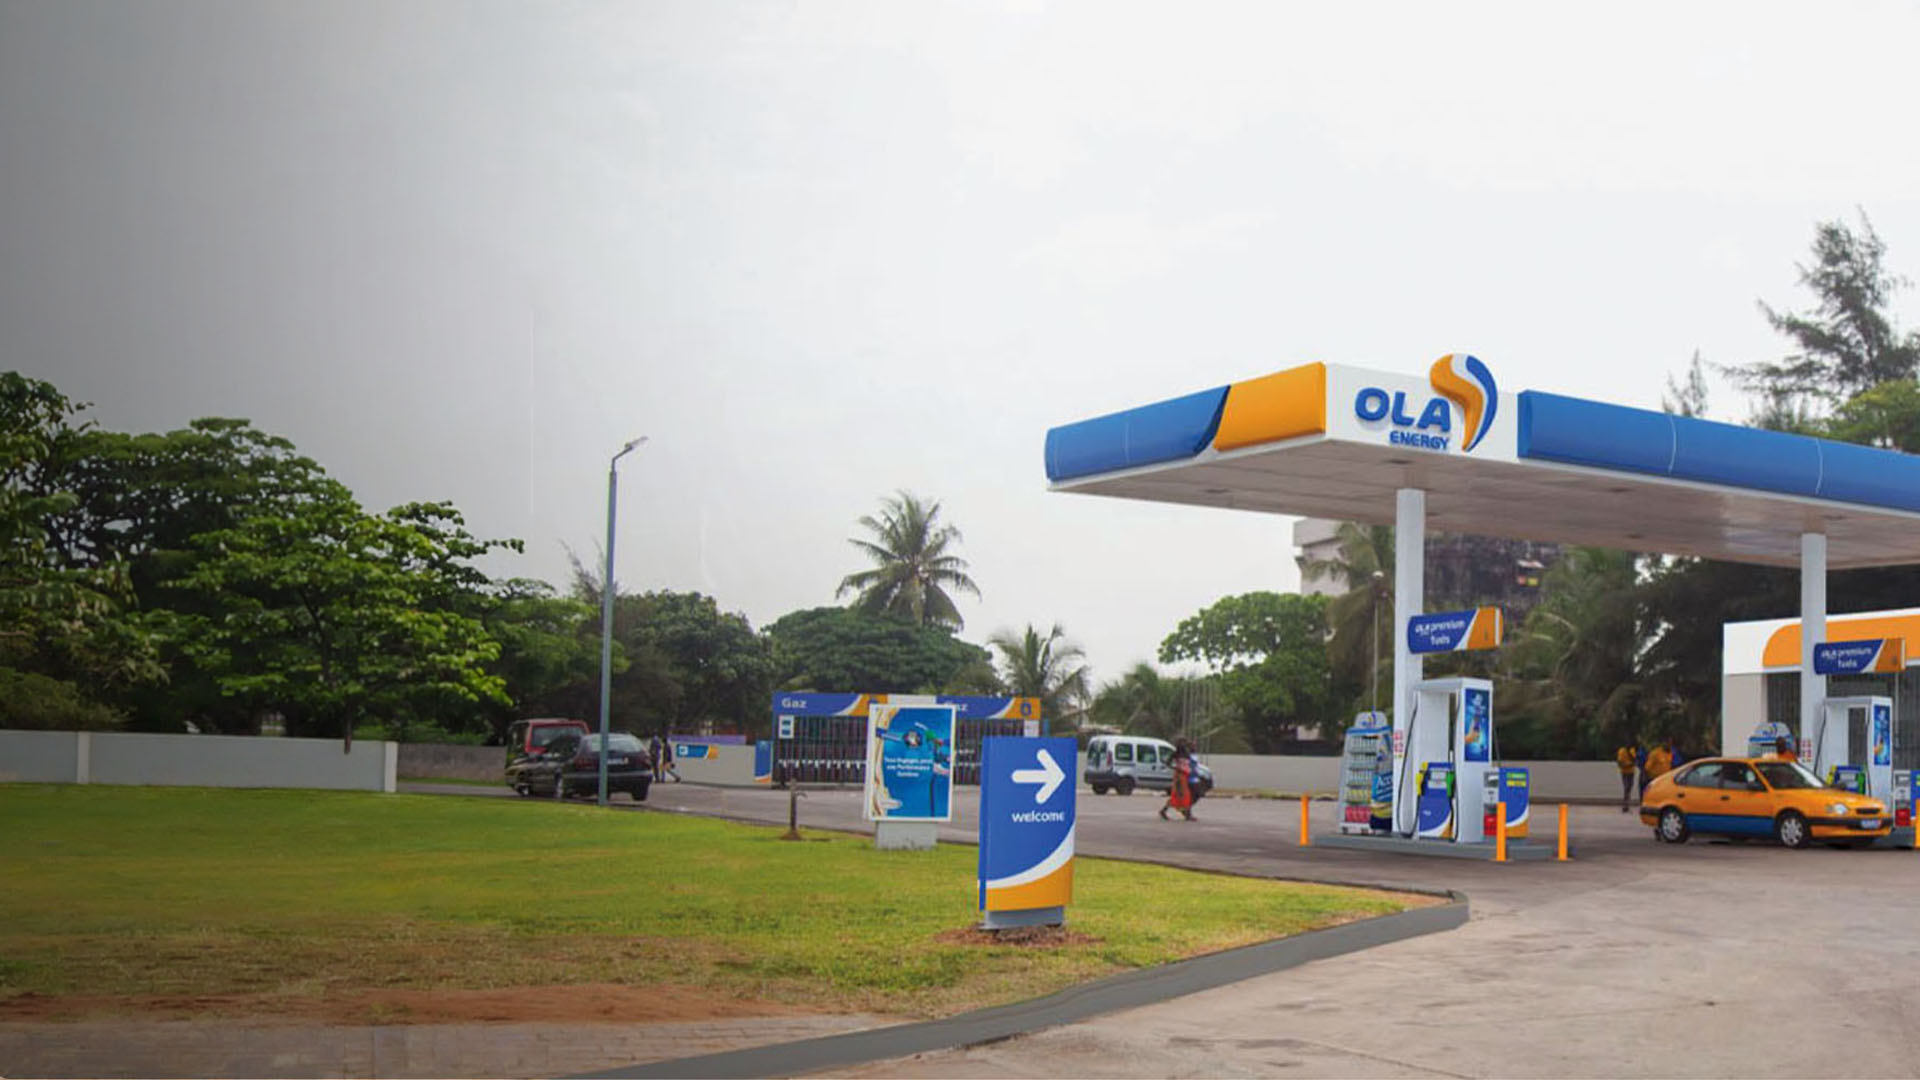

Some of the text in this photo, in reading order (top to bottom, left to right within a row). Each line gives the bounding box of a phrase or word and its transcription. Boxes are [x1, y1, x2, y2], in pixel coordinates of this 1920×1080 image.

[1354, 387, 1452, 433] OLA
[1389, 430, 1450, 450] ENERGY
[781, 697, 807, 709] Gaz
[1011, 810, 1065, 823] welcome
